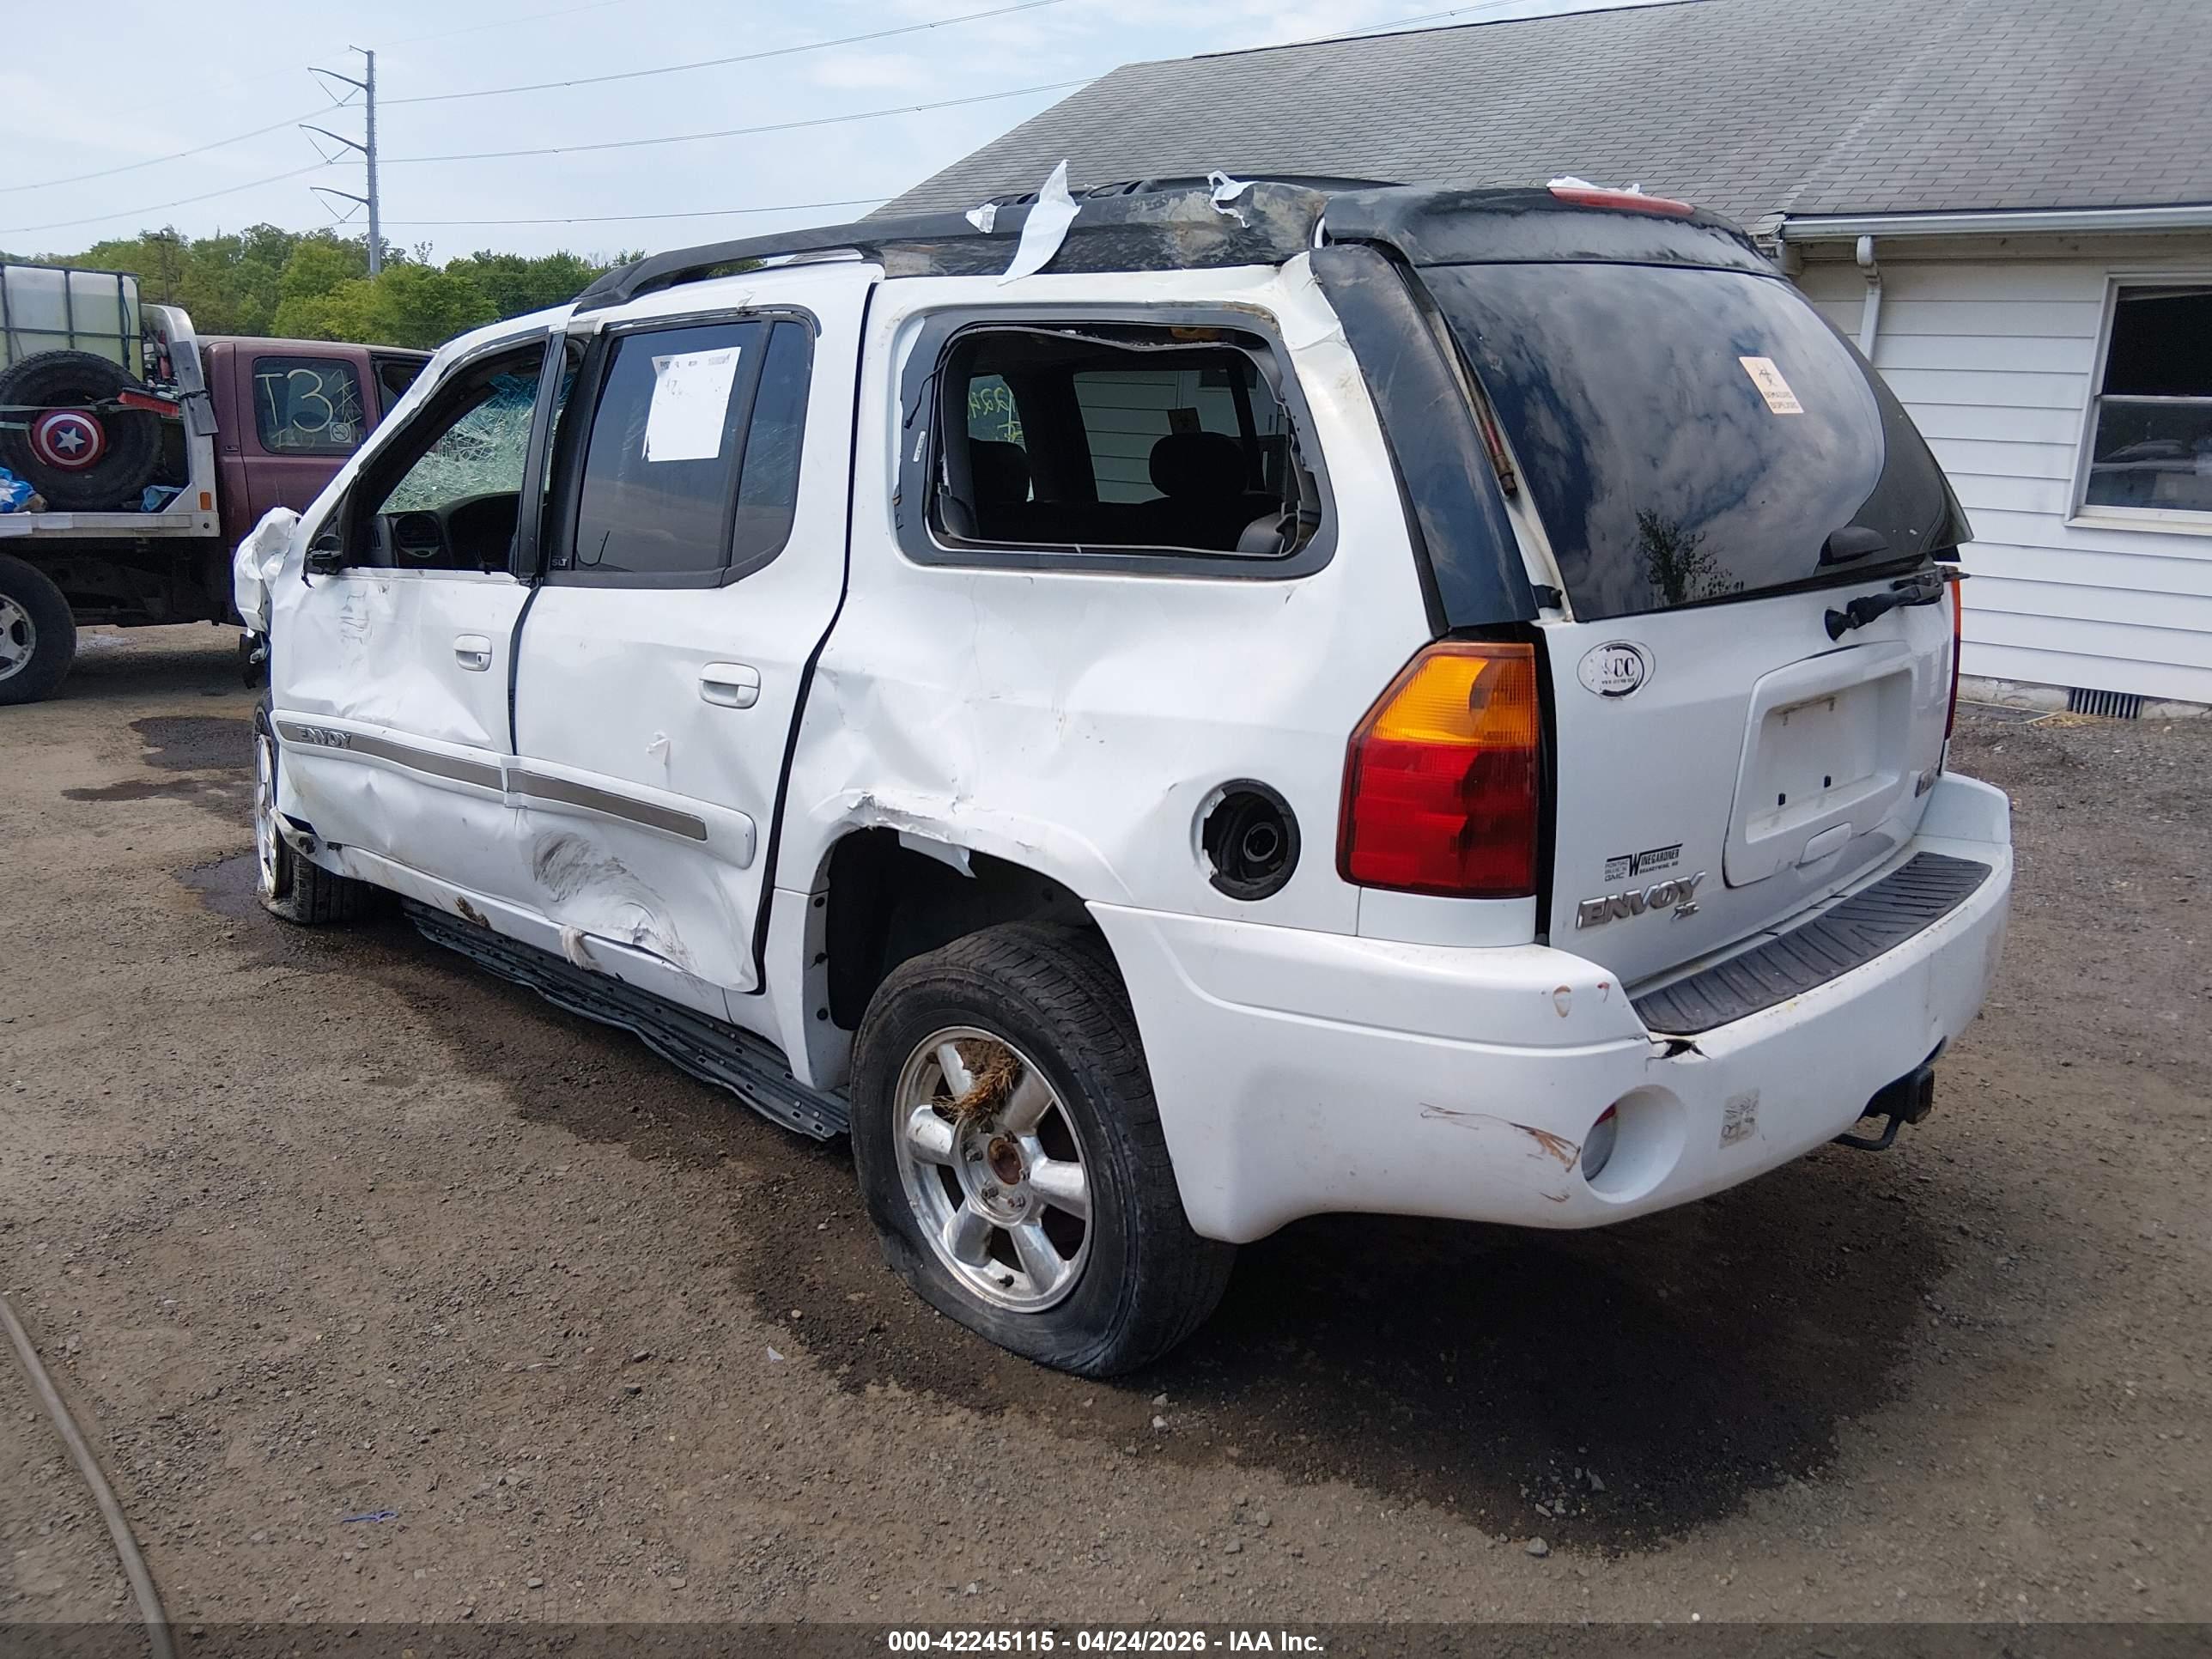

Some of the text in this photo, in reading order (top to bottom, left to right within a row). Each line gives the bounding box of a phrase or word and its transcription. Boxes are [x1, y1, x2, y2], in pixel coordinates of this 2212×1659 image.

[551, 558, 567, 567] SLT
[296, 726, 352, 749] ENVOY
[1576, 870, 1705, 928] ENVOY
